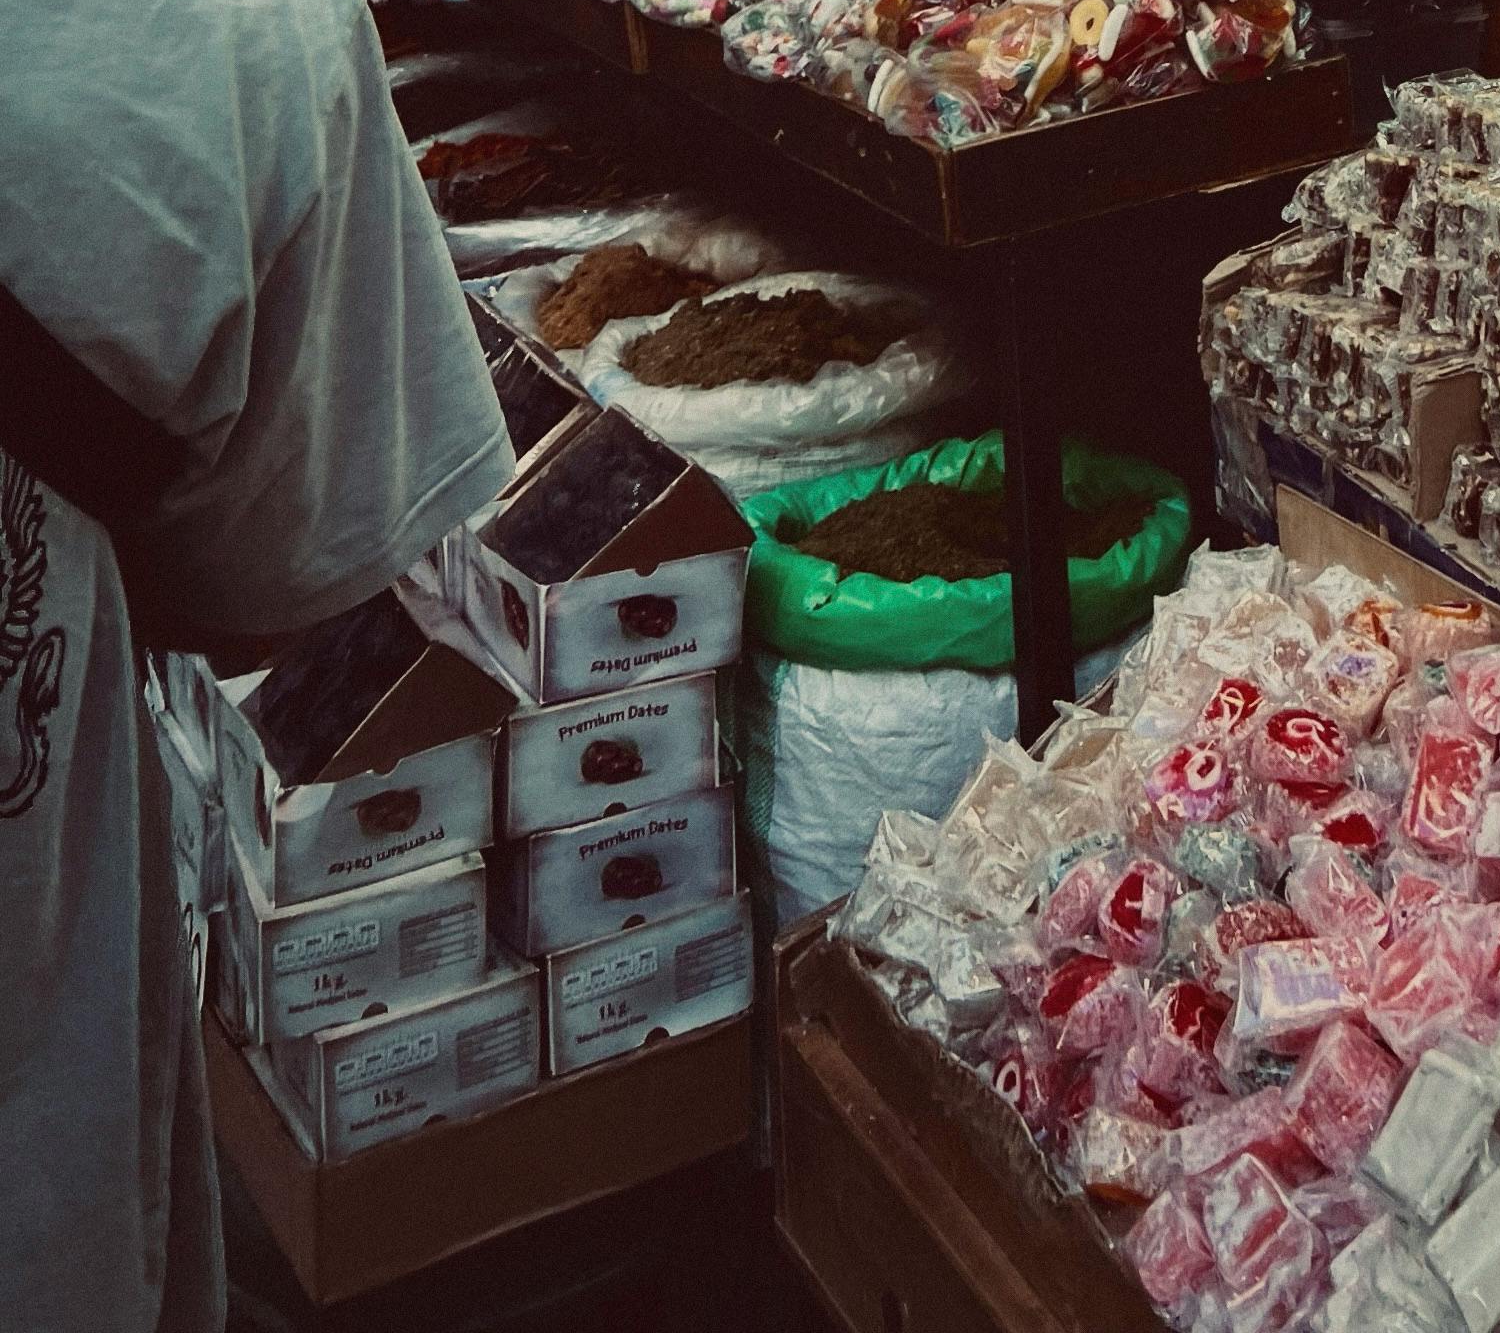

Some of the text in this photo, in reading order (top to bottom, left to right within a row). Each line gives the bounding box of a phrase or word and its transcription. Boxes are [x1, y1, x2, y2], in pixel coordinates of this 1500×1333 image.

[591, 638, 698, 674] Premium Dates
[558, 703, 669, 742] Premium Dates
[328, 827, 445, 876] Premium Dates
[579, 817, 688, 859] Premium Dates
